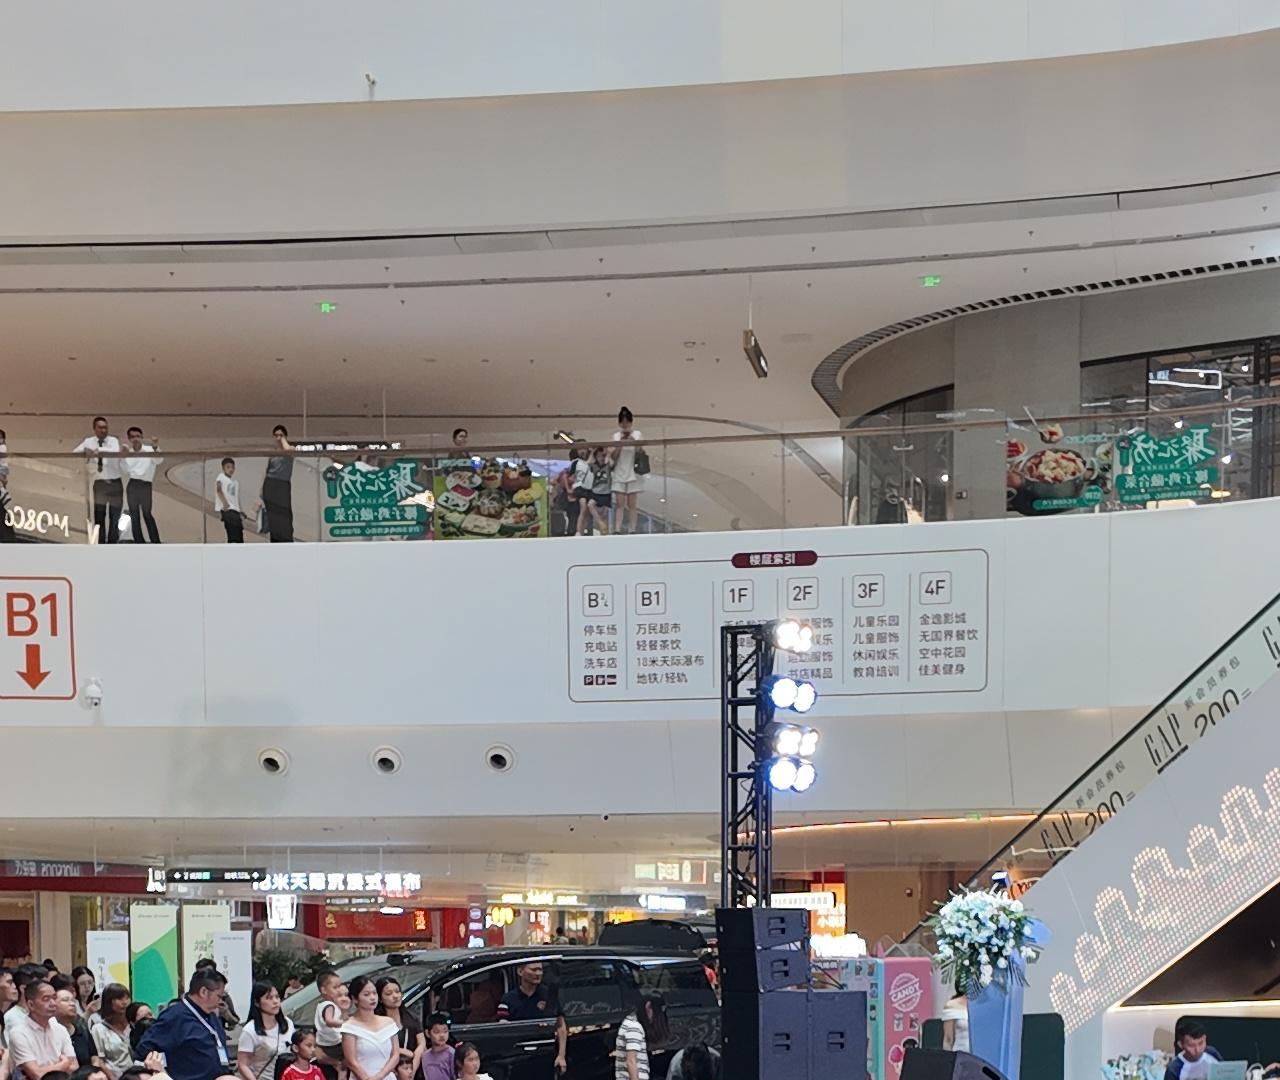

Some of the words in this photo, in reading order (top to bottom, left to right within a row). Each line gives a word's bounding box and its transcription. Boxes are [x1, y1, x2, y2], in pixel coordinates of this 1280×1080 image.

[792, 585, 813, 601] 2F
[857, 582, 879, 598] 3F
[925, 580, 946, 595] 4F
[641, 591, 661, 606] B1
[729, 588, 748, 603] 1F
[6, 592, 60, 638] B1
[853, 615, 899, 628] 儿童乐园
[584, 624, 617, 636] 停车场
[636, 622, 681, 635] 万民超市
[920, 628, 978, 642] 无国界餐饮
[853, 632, 899, 645] 儿童服饰
[584, 641, 617, 653] 充电站
[919, 646, 966, 659] 空中花园
[853, 648, 899, 661] 休闲娱乐
[584, 657, 617, 669] 洗车店
[853, 665, 899, 678] 教育培训
[1144, 713, 1185, 768] GAP
